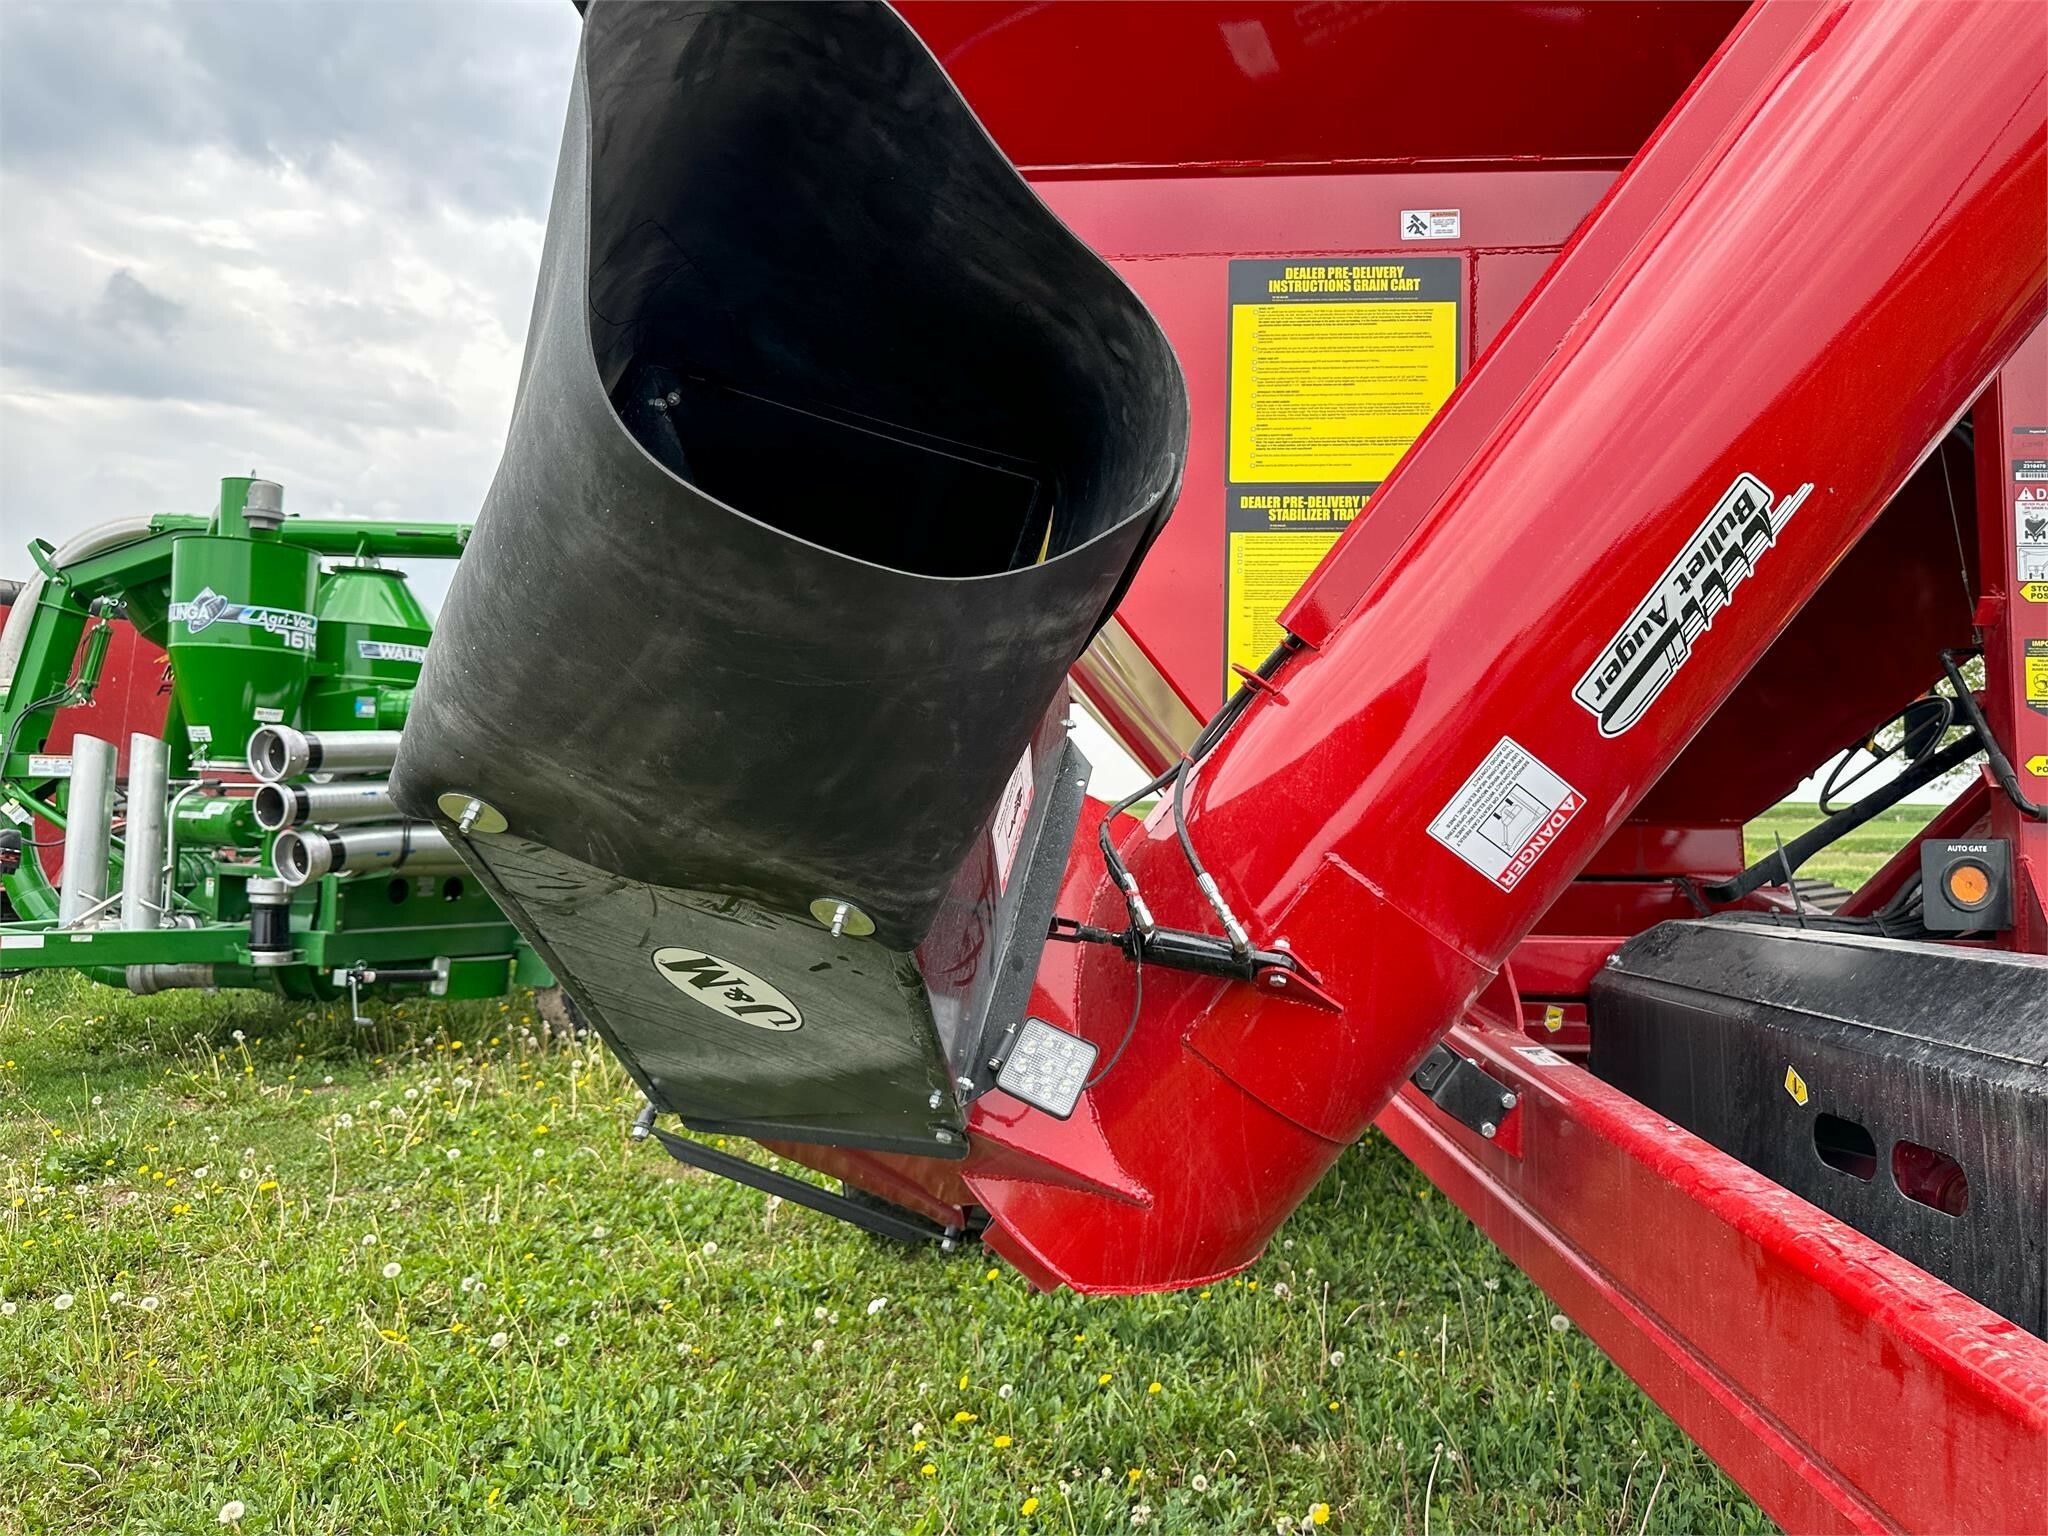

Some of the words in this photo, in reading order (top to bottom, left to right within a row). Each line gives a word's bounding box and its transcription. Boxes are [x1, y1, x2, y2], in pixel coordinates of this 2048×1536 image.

[1285, 266, 1326, 280] DEALER
[1327, 265, 1405, 280] PRE-DELIVERY
[1268, 279, 1351, 293] INSTRUCTIONS
[1353, 278, 1388, 292] GRAIN
[1390, 278, 1421, 291] CART
[1240, 496, 1281, 509] DEALER
[1283, 495, 1360, 509] PRE-DELIVERY
[1268, 508, 1330, 521] STABILIZER
[1673, 488, 1757, 596] Bullet
[274, 629, 317, 651] 7614
[1594, 595, 1669, 701] Auger
[1500, 743, 1509, 752] TO
[1502, 747, 1514, 760] THIS
[1488, 750, 1503, 766] AVOID
[1509, 751, 1519, 762] USE
[1510, 755, 1524, 771] FROM
[1471, 764, 1491, 787] CONTACT
[1485, 758, 1505, 780] MACHINE
[1498, 761, 1511, 776] CARE
[1474, 779, 1488, 793] NEAR
[1486, 774, 1500, 790] WHEN
[1493, 769, 1513, 792] CONTACT
[1456, 791, 1477, 815] ELECTRIC
[1471, 788, 1488, 808] MOVING
[1483, 790, 1495, 803] WITH
[1491, 795, 1499, 804] OR
[1464, 802, 1485, 825] ELECTRIC
[1465, 806, 1473, 815] OR
[1478, 803, 1493, 820] DEATH
[1444, 813, 1467, 840] OPERATING
[1469, 818, 1480, 830] CAN
[1455, 828, 1472, 847] RESULT
[1499, 810, 1566, 887] DANGER
[1947, 844, 1967, 852] AUTO
[1968, 844, 1987, 853] GATE
[658, 955, 797, 1028] J&M
